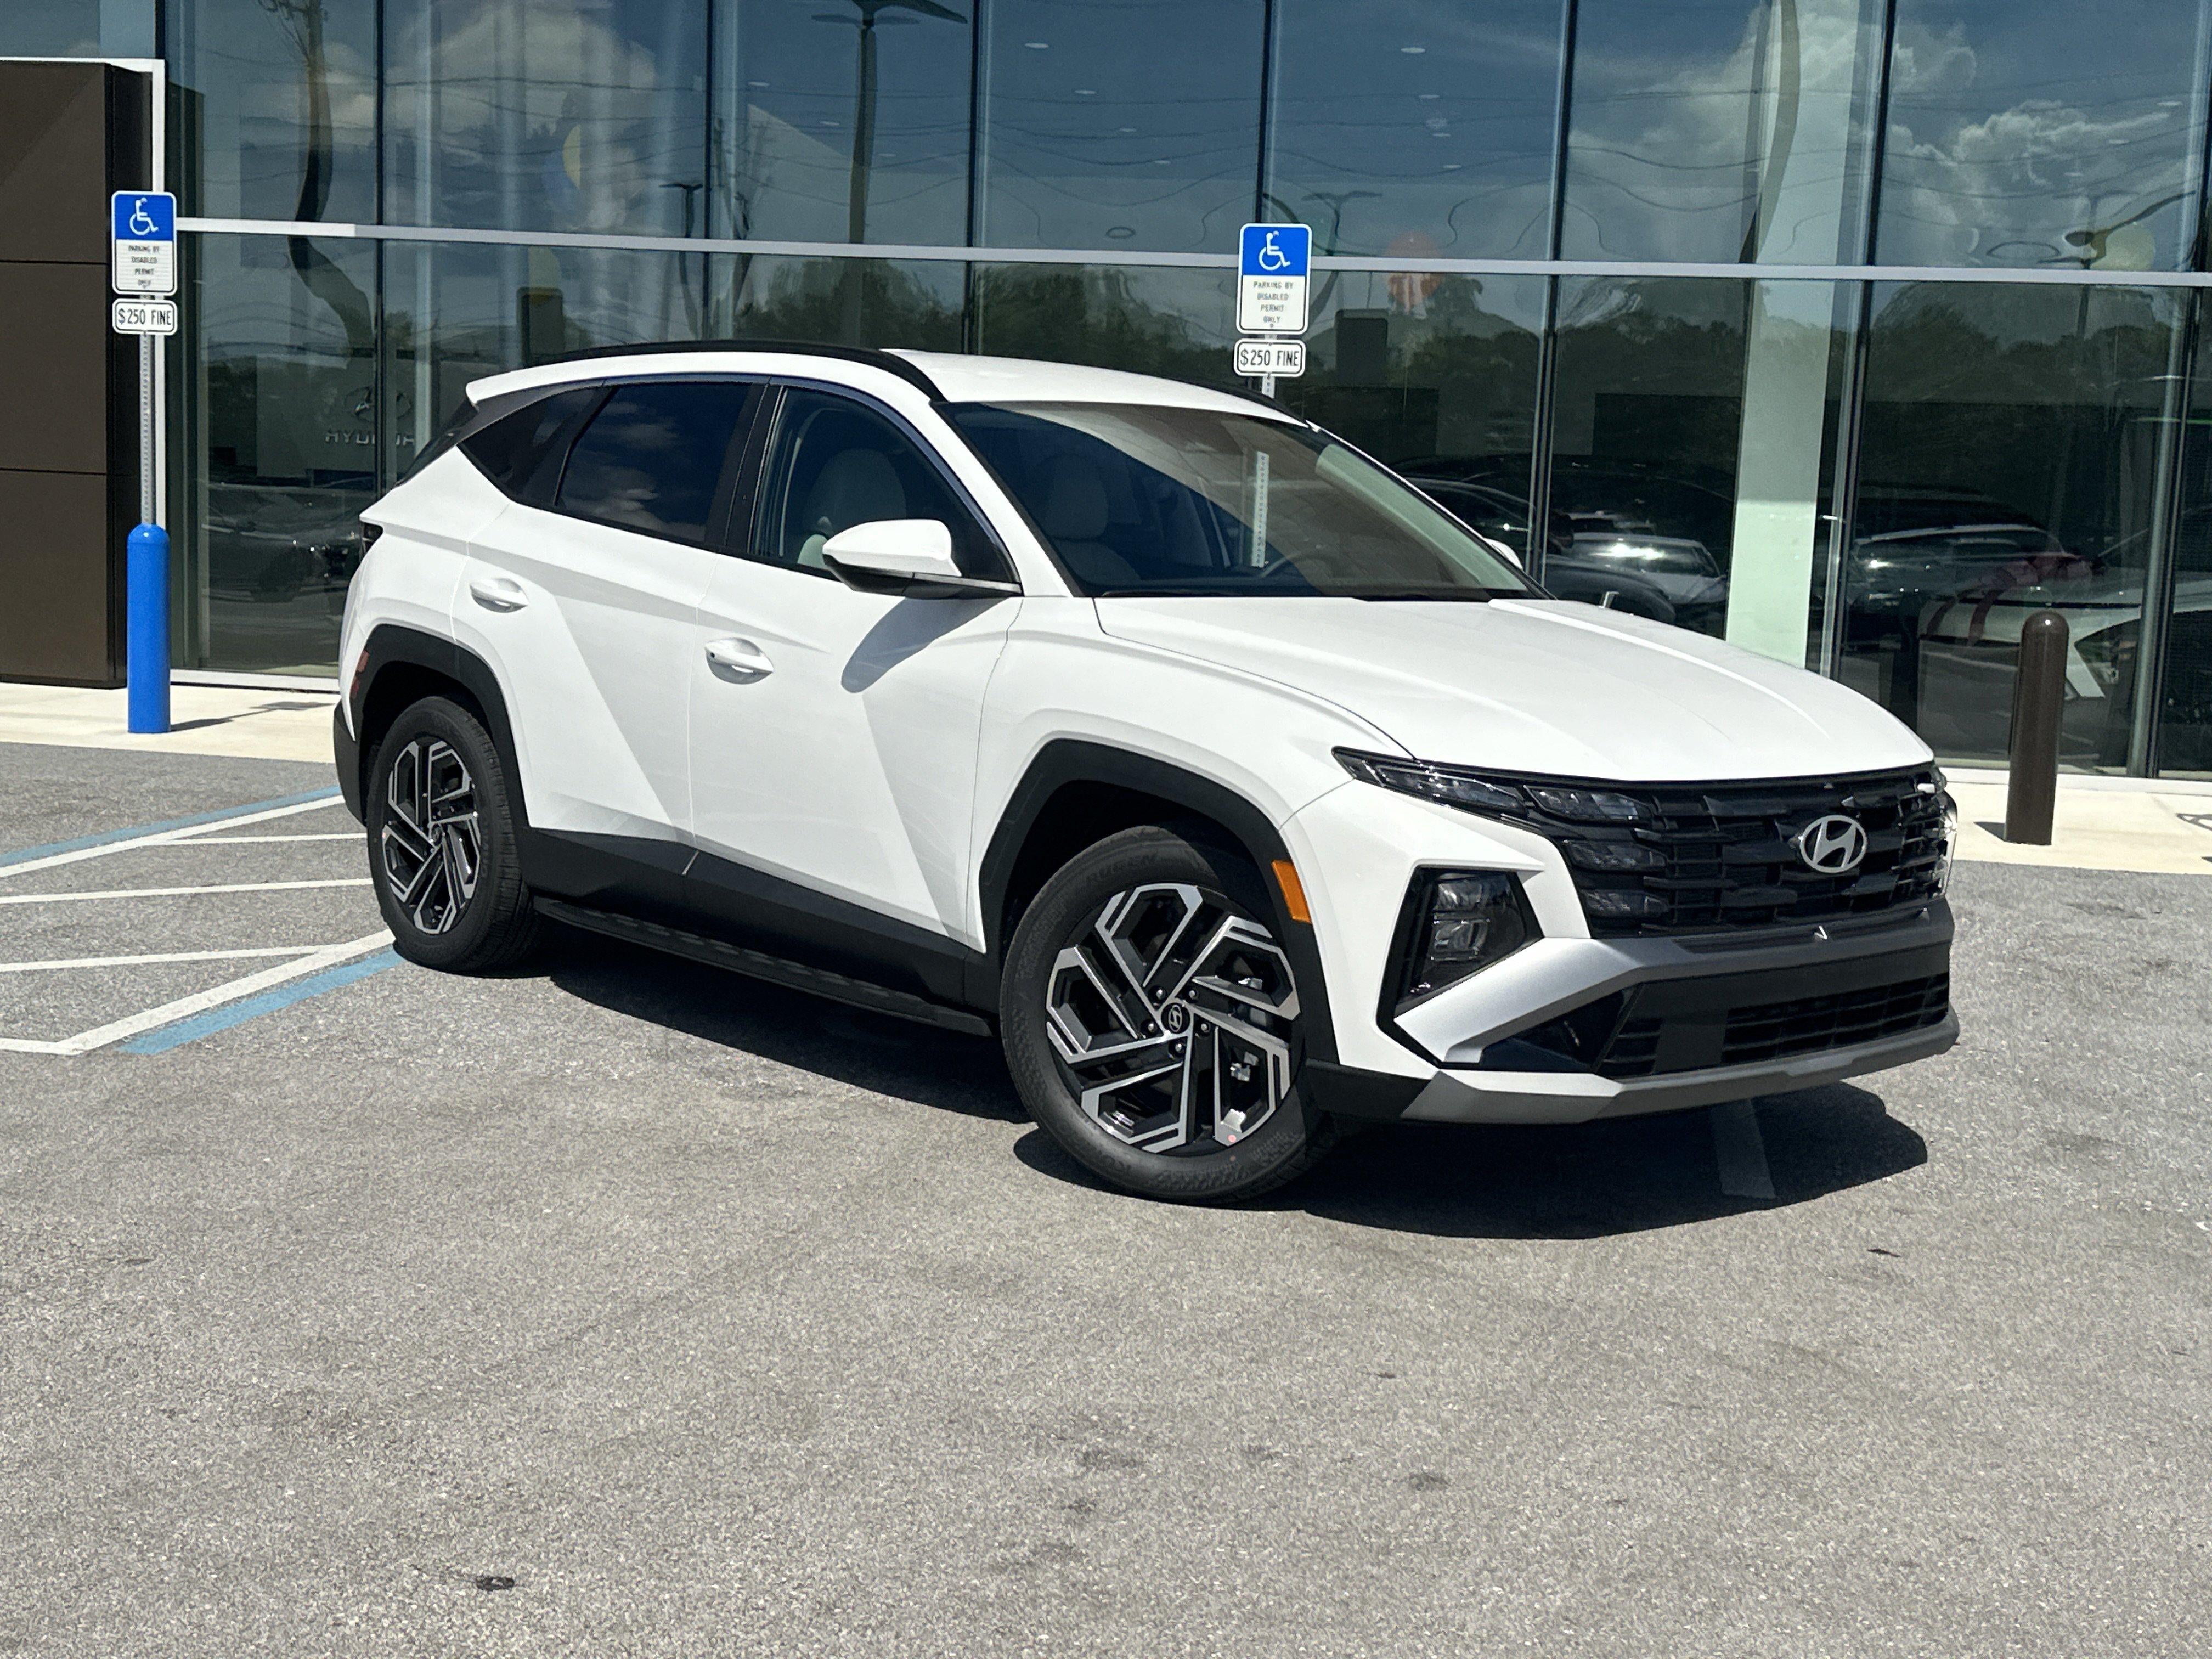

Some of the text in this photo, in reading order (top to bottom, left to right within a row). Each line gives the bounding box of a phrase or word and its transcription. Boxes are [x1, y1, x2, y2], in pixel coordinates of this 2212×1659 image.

[1257, 292, 1289, 301] DISABLED
[1261, 304, 1284, 312] PERMIT
[118, 308, 171, 325] $250 FINE
[1240, 348, 1300, 366] $250 FINE
